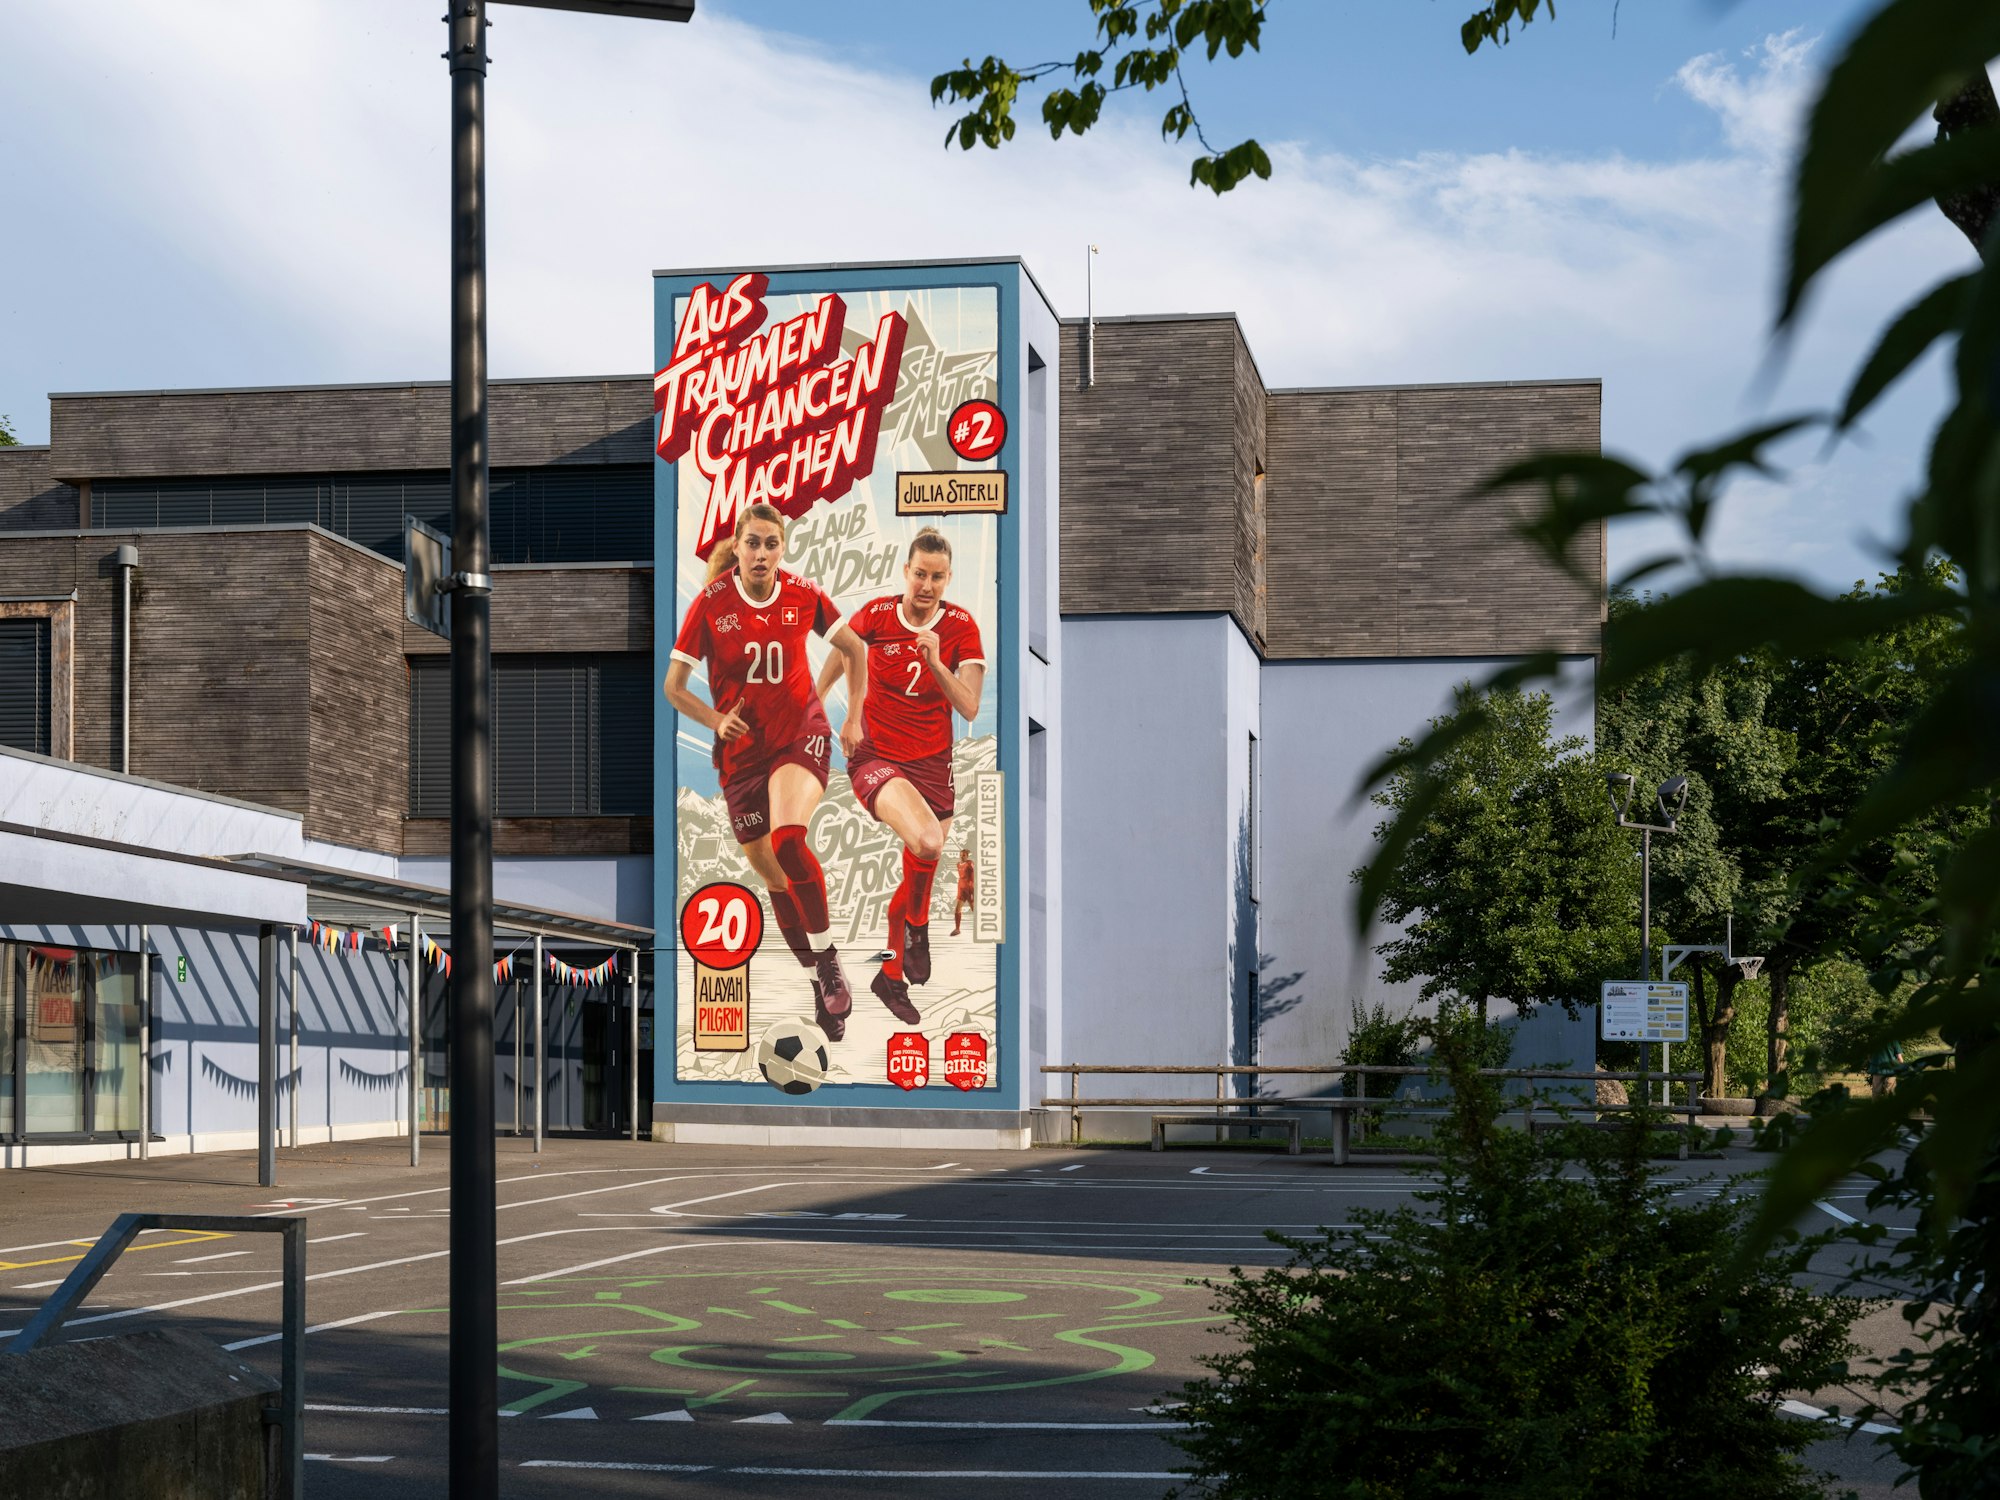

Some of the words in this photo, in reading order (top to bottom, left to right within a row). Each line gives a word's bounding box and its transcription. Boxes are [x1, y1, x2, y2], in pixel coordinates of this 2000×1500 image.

[673, 272, 757, 362] AUS
[653, 295, 835, 448] TRÄUMEN
[696, 312, 896, 477] CHANCEN
[953, 410, 996, 451] #2
[699, 406, 868, 548] MACHEN
[903, 481, 944, 505] JULIA
[946, 479, 999, 504] STIERLI
[783, 503, 868, 564] GLAUB
[711, 580, 727, 593] UBS
[796, 578, 812, 590] UBS
[878, 601, 894, 611] UBS
[955, 611, 969, 622] UBS
[744, 640, 784, 684] 20
[904, 660, 922, 697] 2
[804, 734, 825, 758] 20
[873, 765, 896, 779] UBS
[743, 810, 764, 828] UBS
[980, 778, 998, 827] ALLES!
[805, 802, 860, 865] GO
[837, 838, 898, 907] FOR
[980, 830, 998, 907] SCHAFFST
[695, 897, 748, 953] 20
[845, 890, 896, 945] IT
[980, 913, 998, 932] DU
[699, 976, 743, 1002] ALAYAH
[699, 1007, 743, 1032] PILGRIM
[889, 1055, 927, 1074] CUP
[944, 1058, 988, 1075] GIRLS
